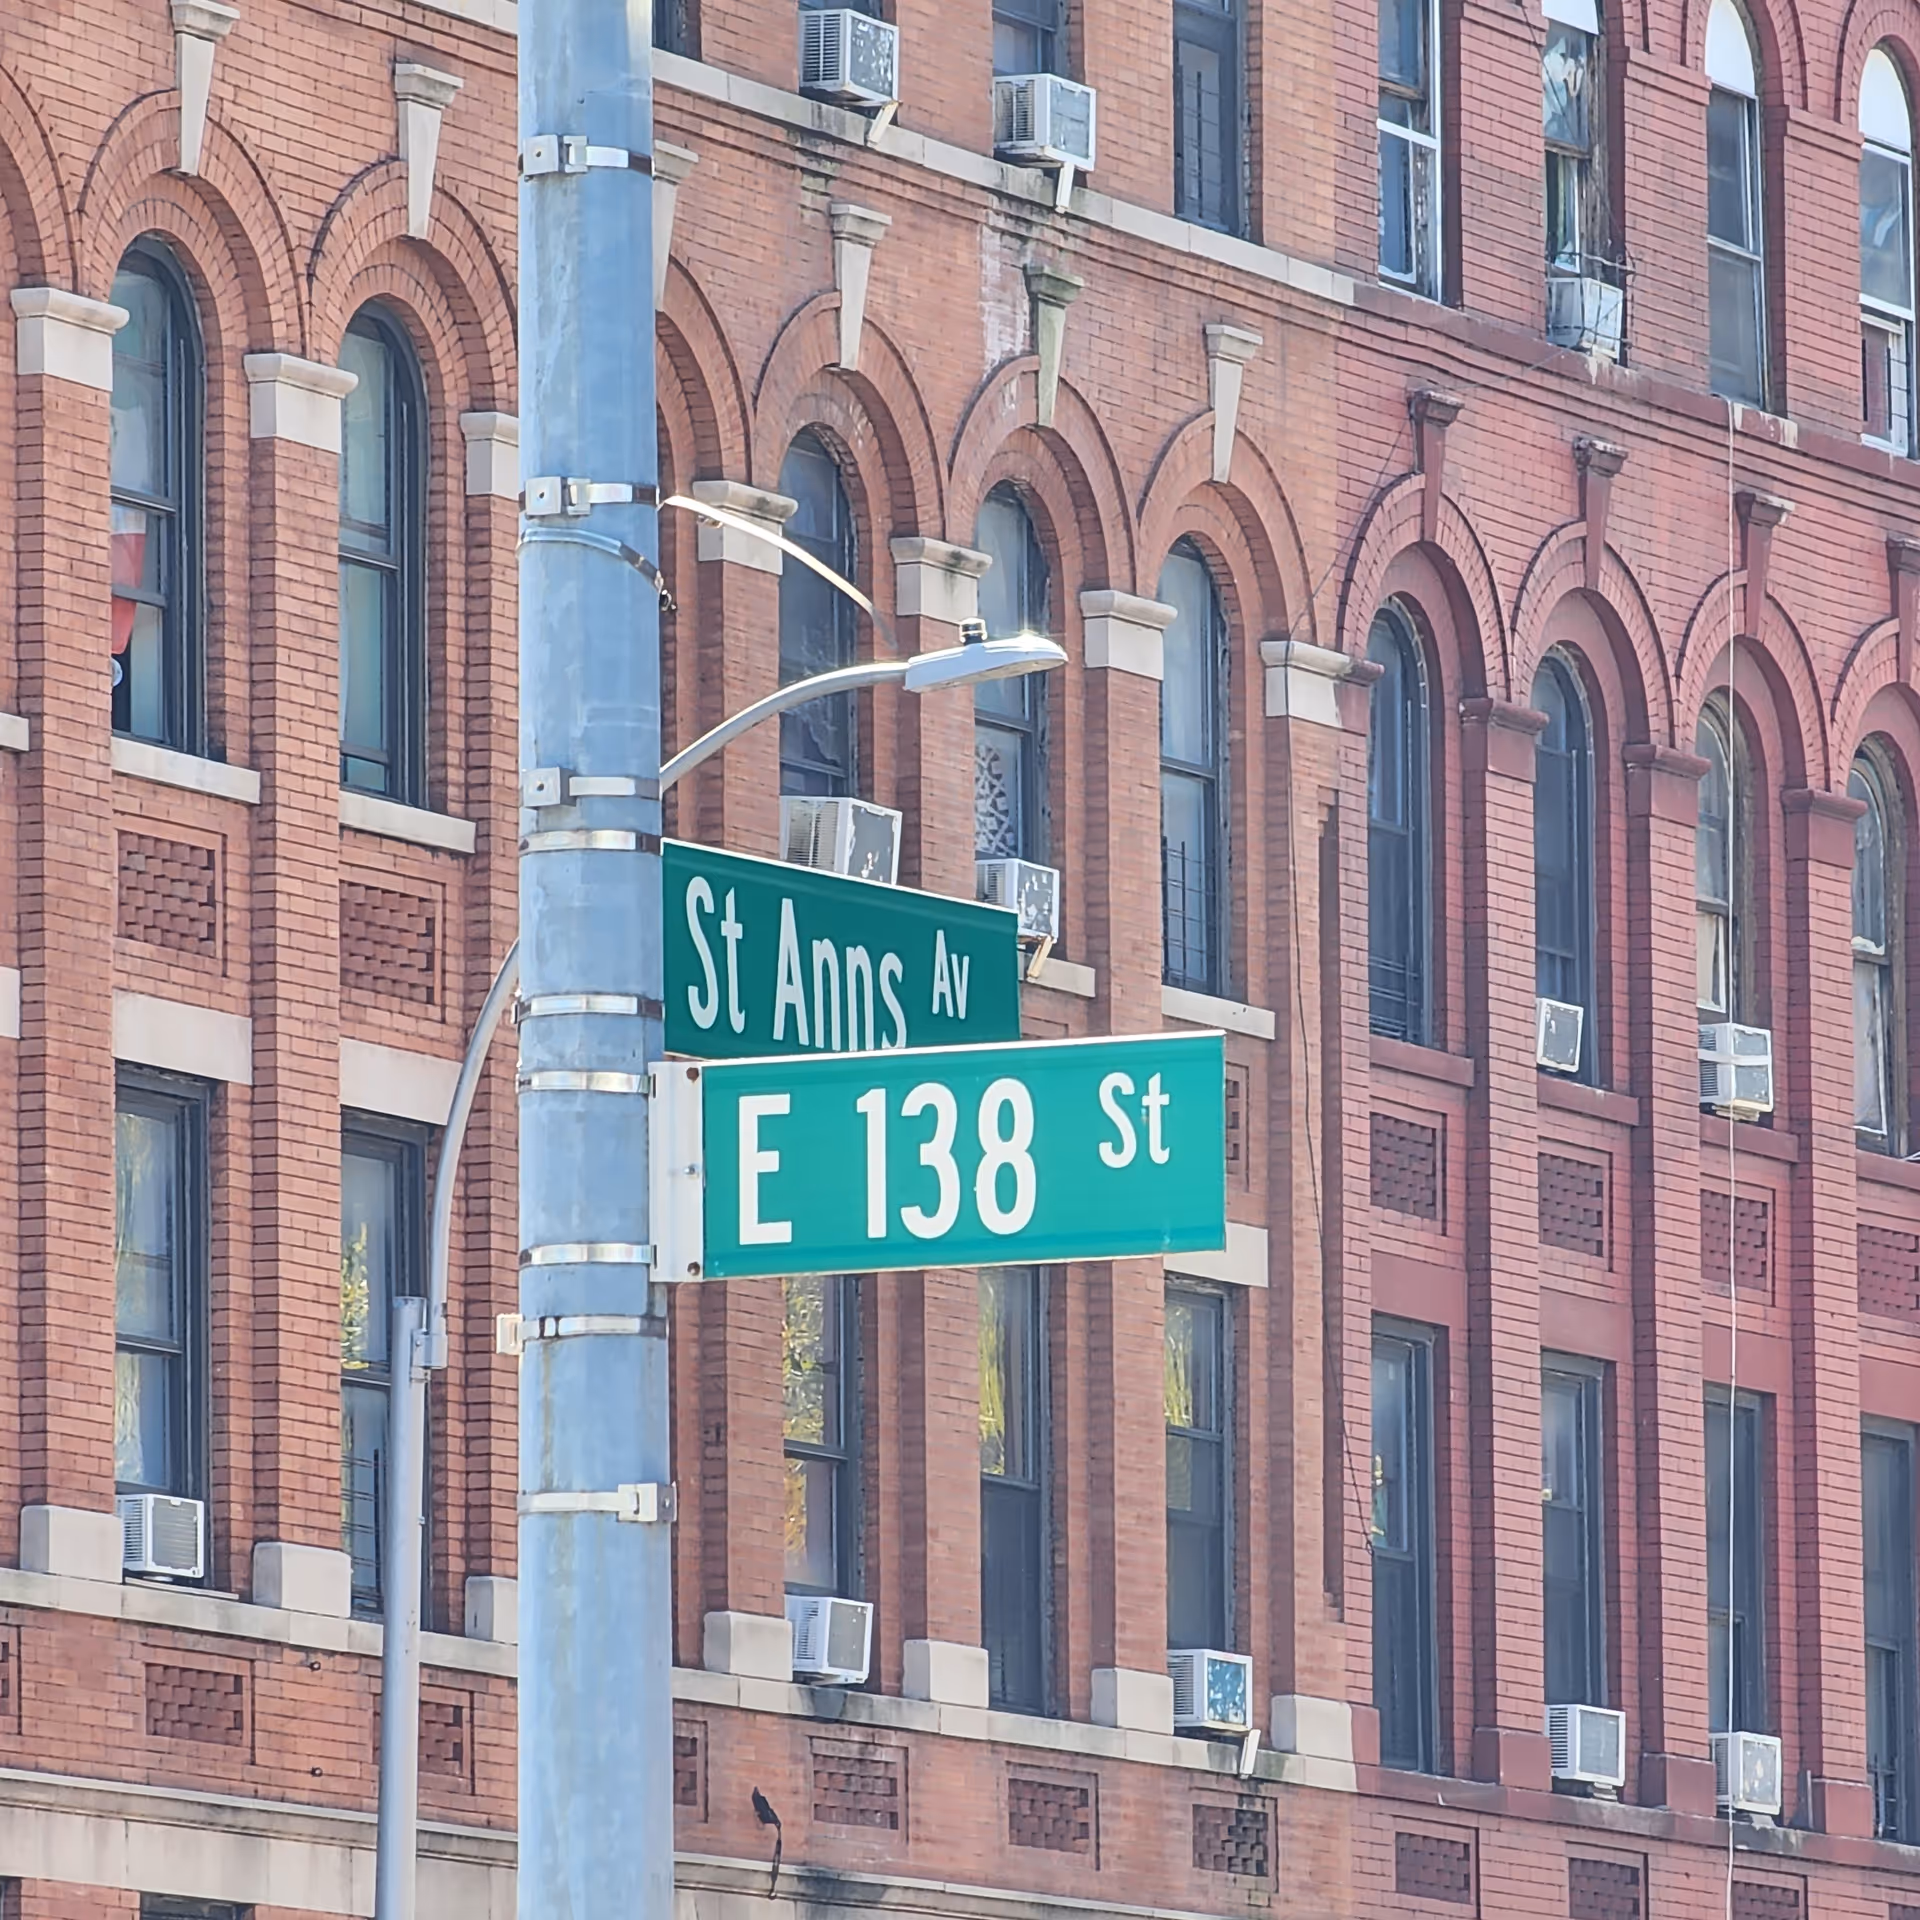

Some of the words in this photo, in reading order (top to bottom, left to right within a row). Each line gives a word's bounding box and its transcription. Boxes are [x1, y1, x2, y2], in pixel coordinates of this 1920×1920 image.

[685, 876, 745, 1034] St
[773, 897, 908, 1051] Anns
[931, 929, 970, 1019] Av
[738, 1092, 793, 1246] E
[855, 1077, 1037, 1239] 138
[1098, 1071, 1171, 1169] St
